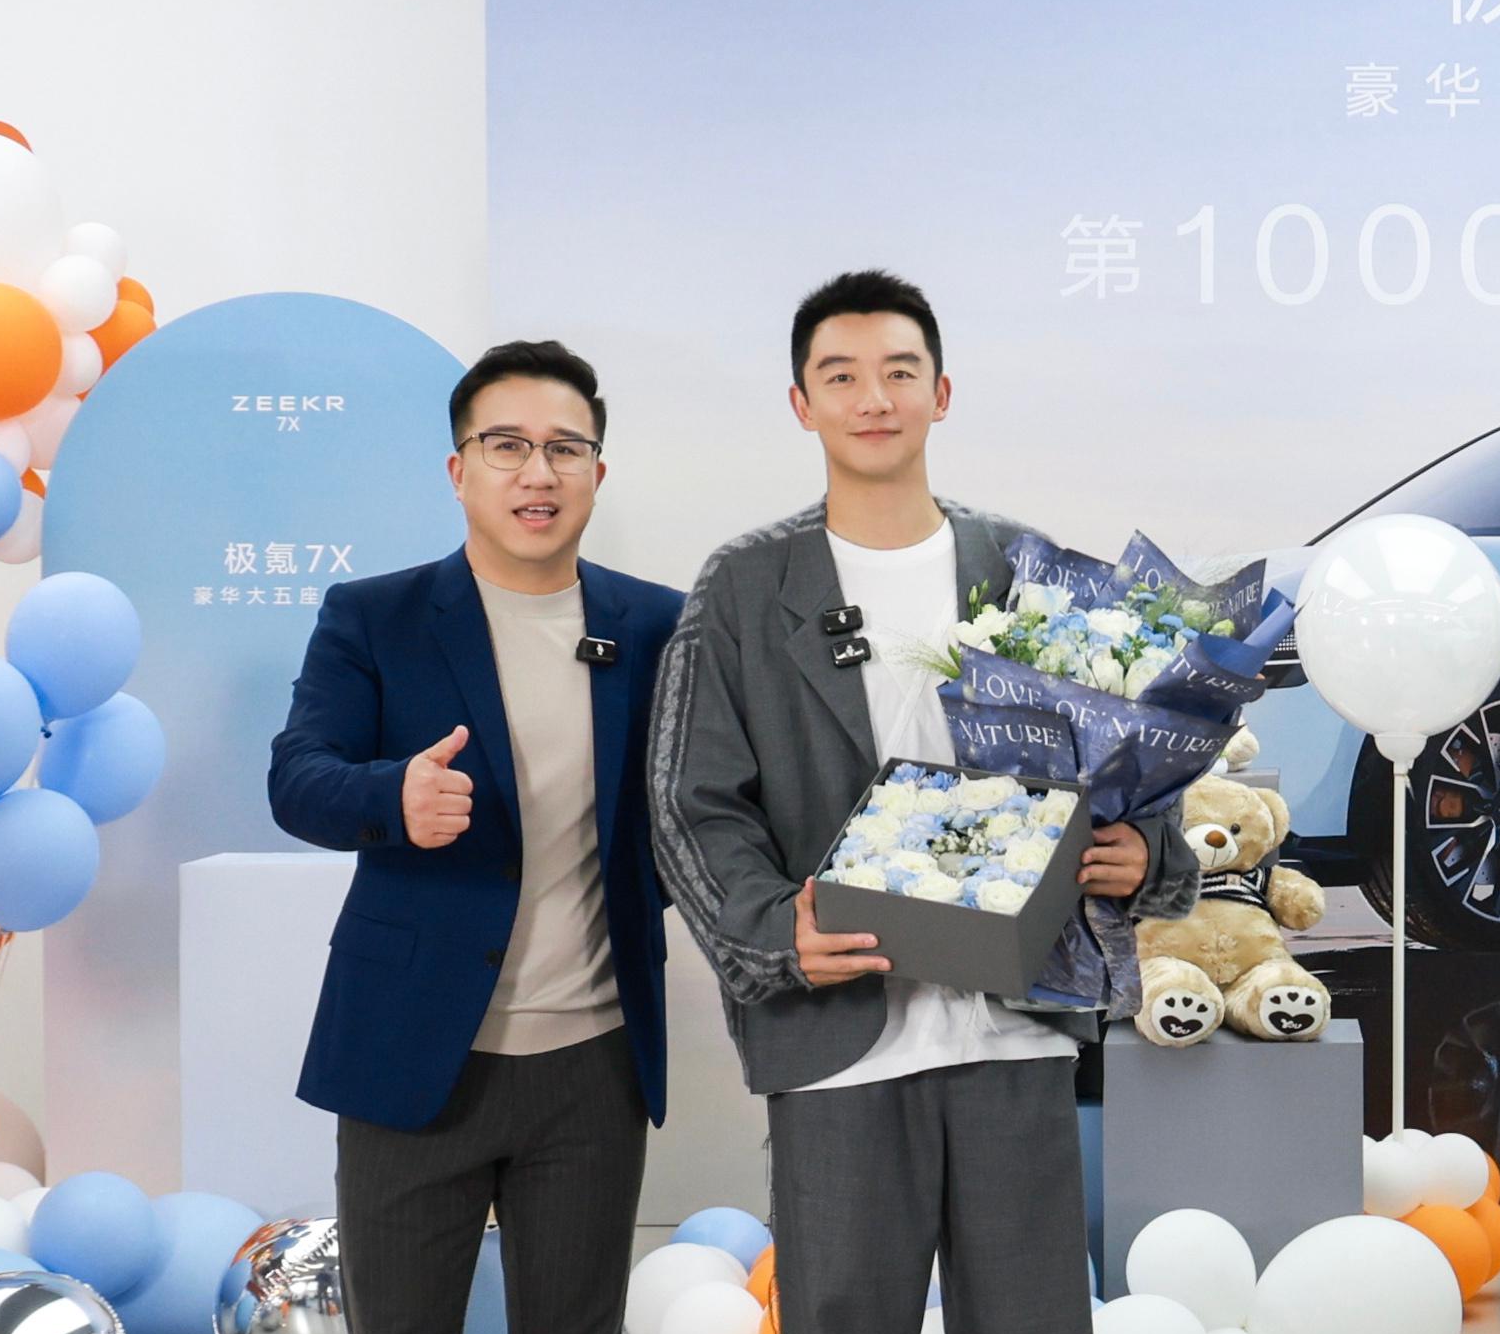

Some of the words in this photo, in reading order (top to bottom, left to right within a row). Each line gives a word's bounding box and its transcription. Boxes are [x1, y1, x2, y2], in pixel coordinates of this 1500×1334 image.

[231, 394, 345, 413] ZEEKR
[276, 415, 301, 433] 7X
[223, 540, 354, 575] 极氪7X
[971, 667, 1043, 711] LOVE
